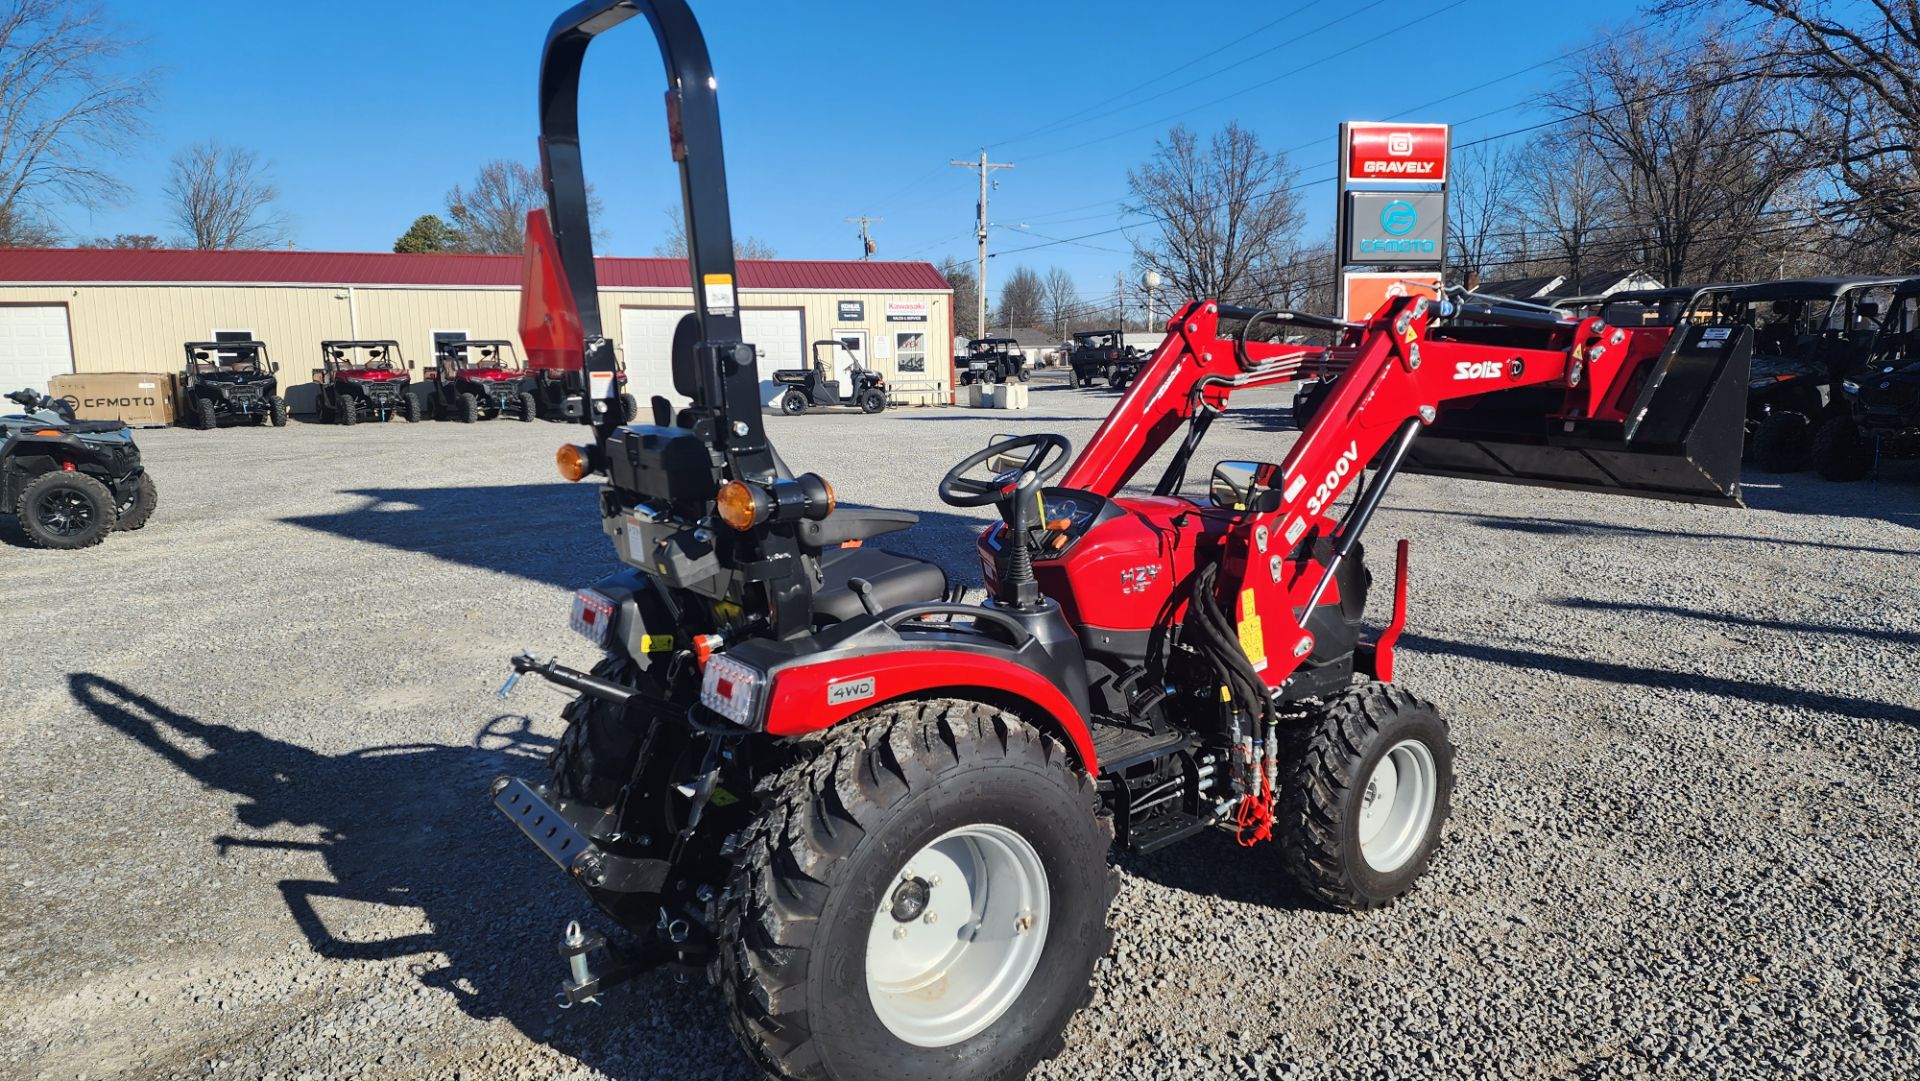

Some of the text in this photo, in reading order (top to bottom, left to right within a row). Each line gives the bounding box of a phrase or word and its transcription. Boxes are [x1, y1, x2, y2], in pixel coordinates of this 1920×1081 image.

[1363, 160, 1435, 173] GRAVELY
[1360, 238, 1435, 253] CFMOTO
[84, 397, 155, 408] CFMOTO
[1306, 440, 1360, 517] 3200V
[833, 682, 871, 698] 4WD
